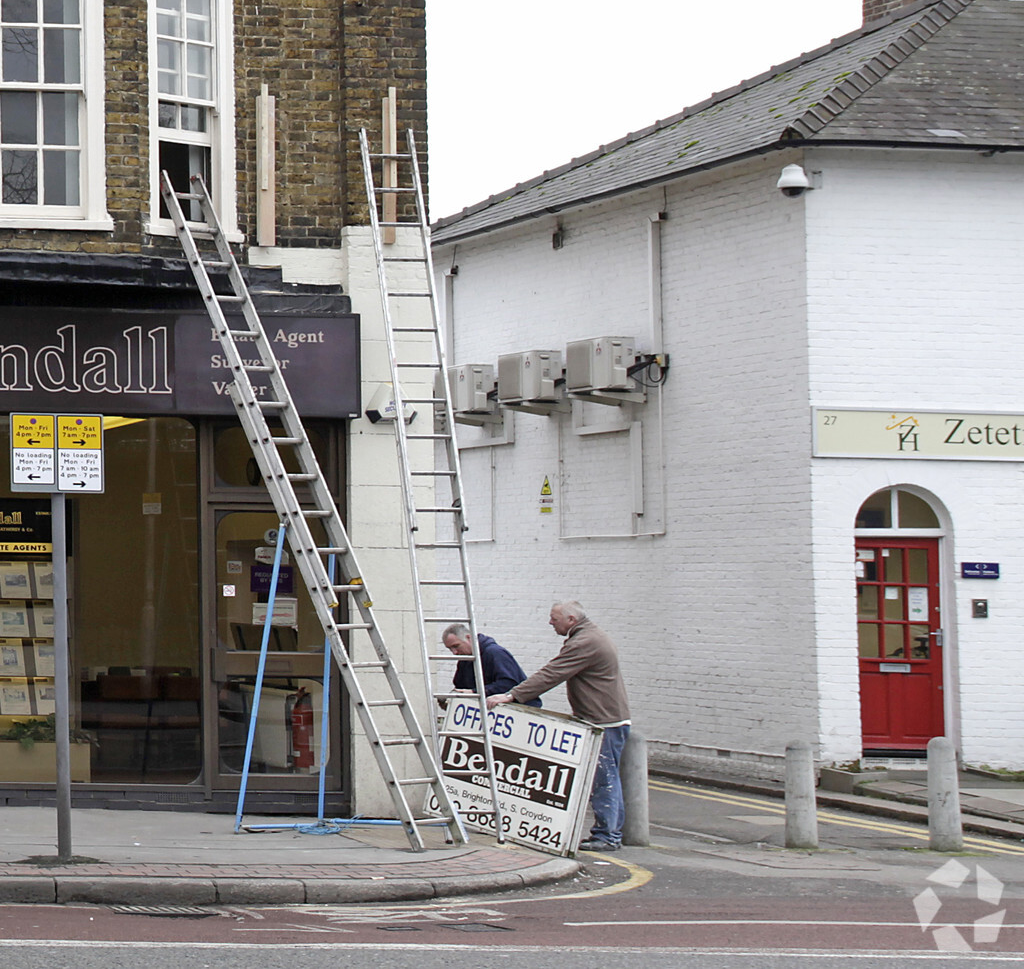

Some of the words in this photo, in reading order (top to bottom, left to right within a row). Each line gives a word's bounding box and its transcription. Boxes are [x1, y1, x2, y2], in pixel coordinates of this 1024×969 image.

[273, 329, 325, 348] Agent
[212, 382, 268, 396] Vaer
[823, 415, 837, 426] 27
[943, 418, 1024, 445] Zetet
[527, 722, 547, 748] TO
[550, 728, 582, 756] LET
[471, 775, 531, 799] COMERCIAL
[510, 804, 517, 813] S.
[520, 807, 553, 824] Croydon
[517, 820, 562, 848] 5424
